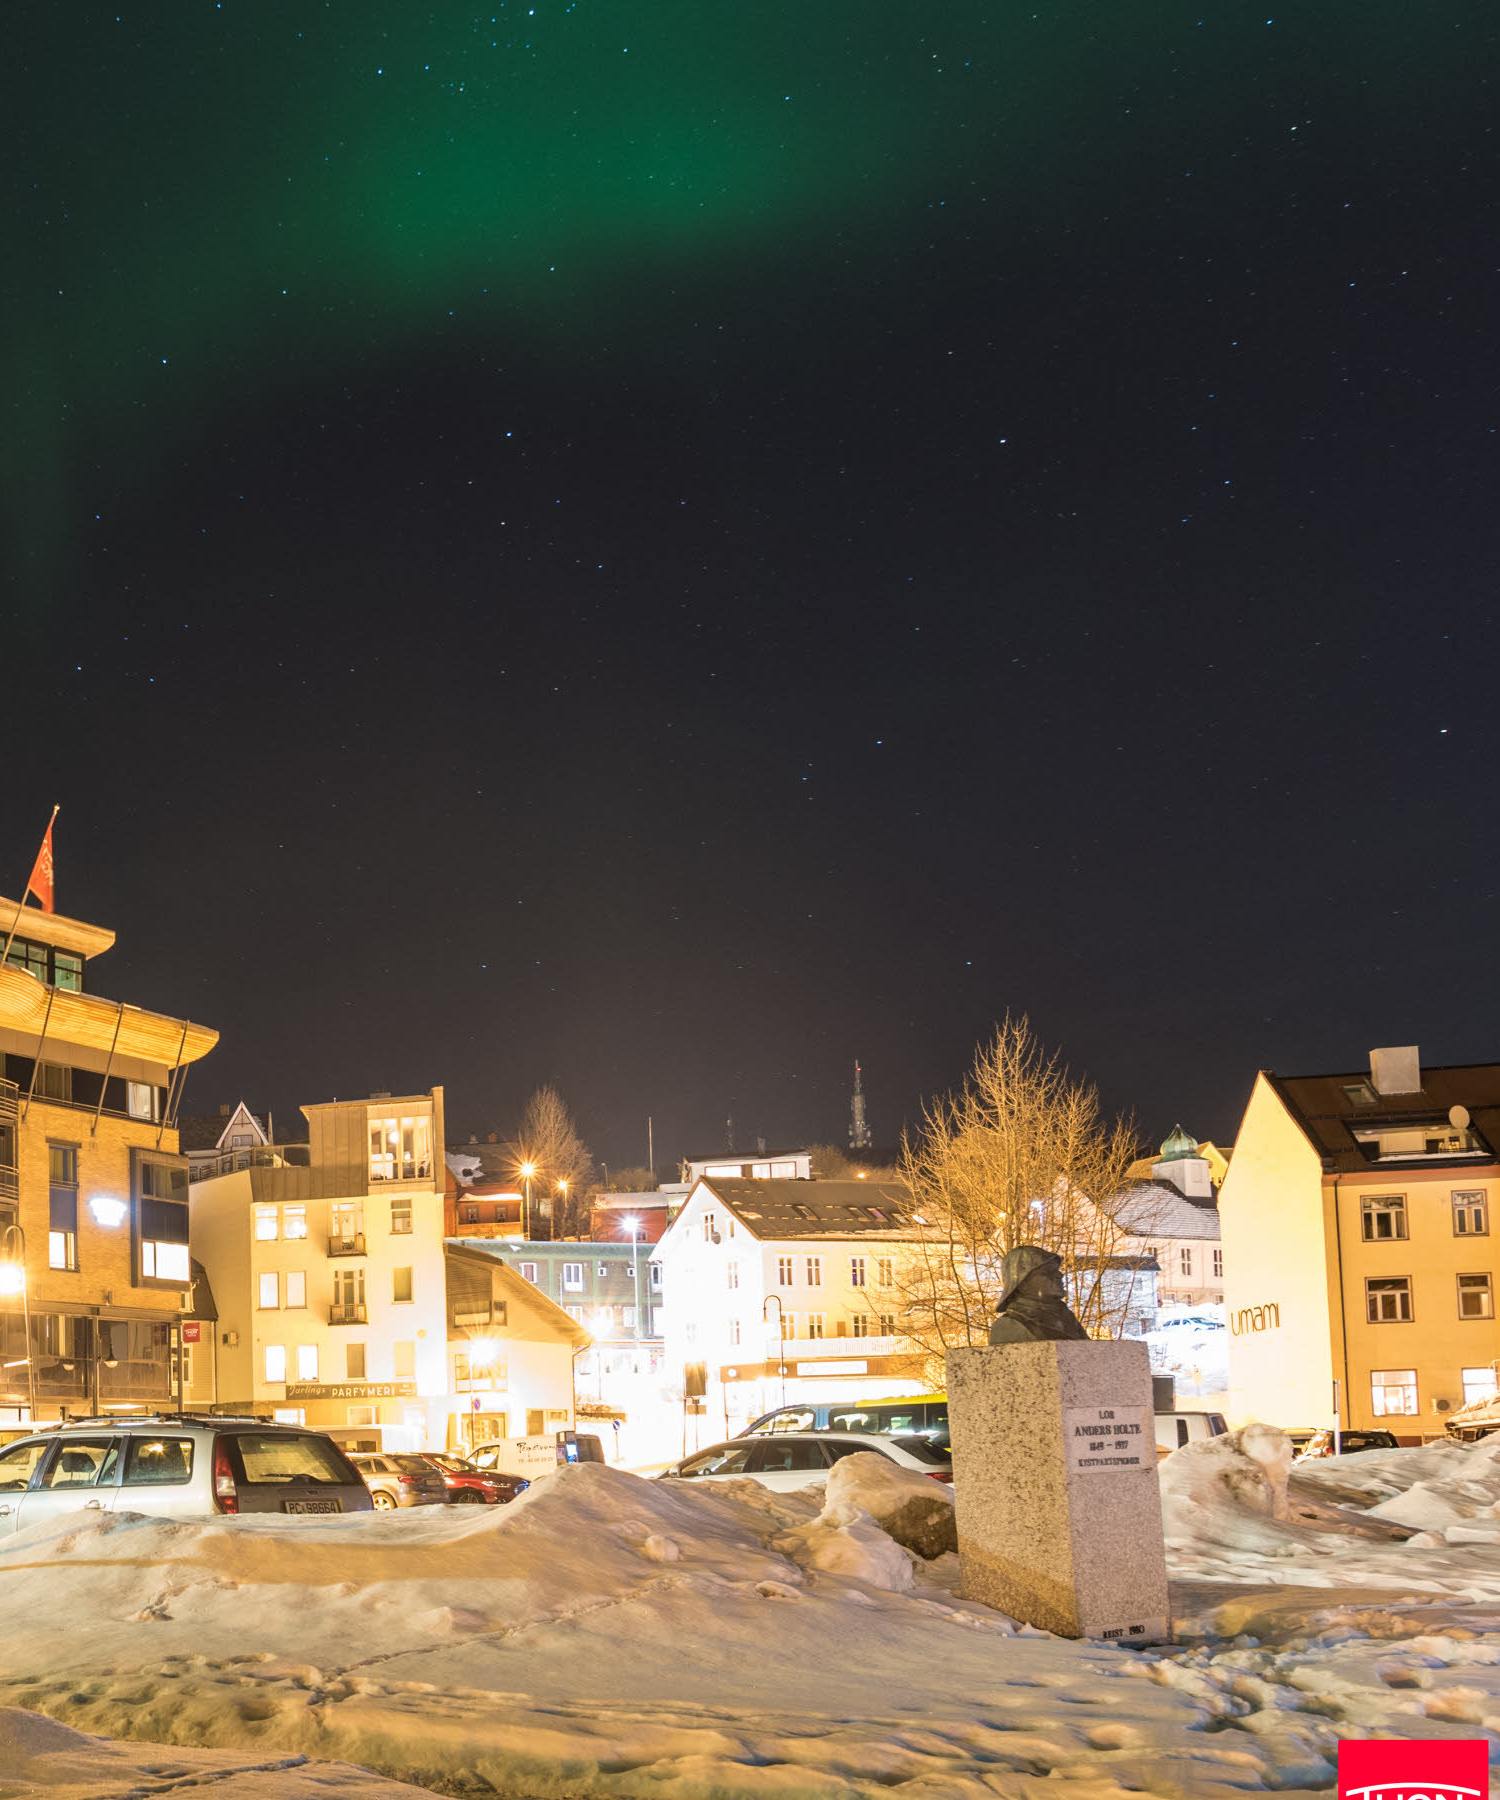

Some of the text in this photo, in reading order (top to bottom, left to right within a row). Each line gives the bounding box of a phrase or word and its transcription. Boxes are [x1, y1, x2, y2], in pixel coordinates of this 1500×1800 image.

[1230, 1302, 1280, 1336] umami
[332, 1386, 396, 1398] PARFYMERI
[1099, 1410, 1115, 1420] LOS
[1075, 1424, 1142, 1437] ANDERS HOLTE
[288, 1502, 336, 1514] PC 98664
[1102, 1628, 1124, 1639] REIST
